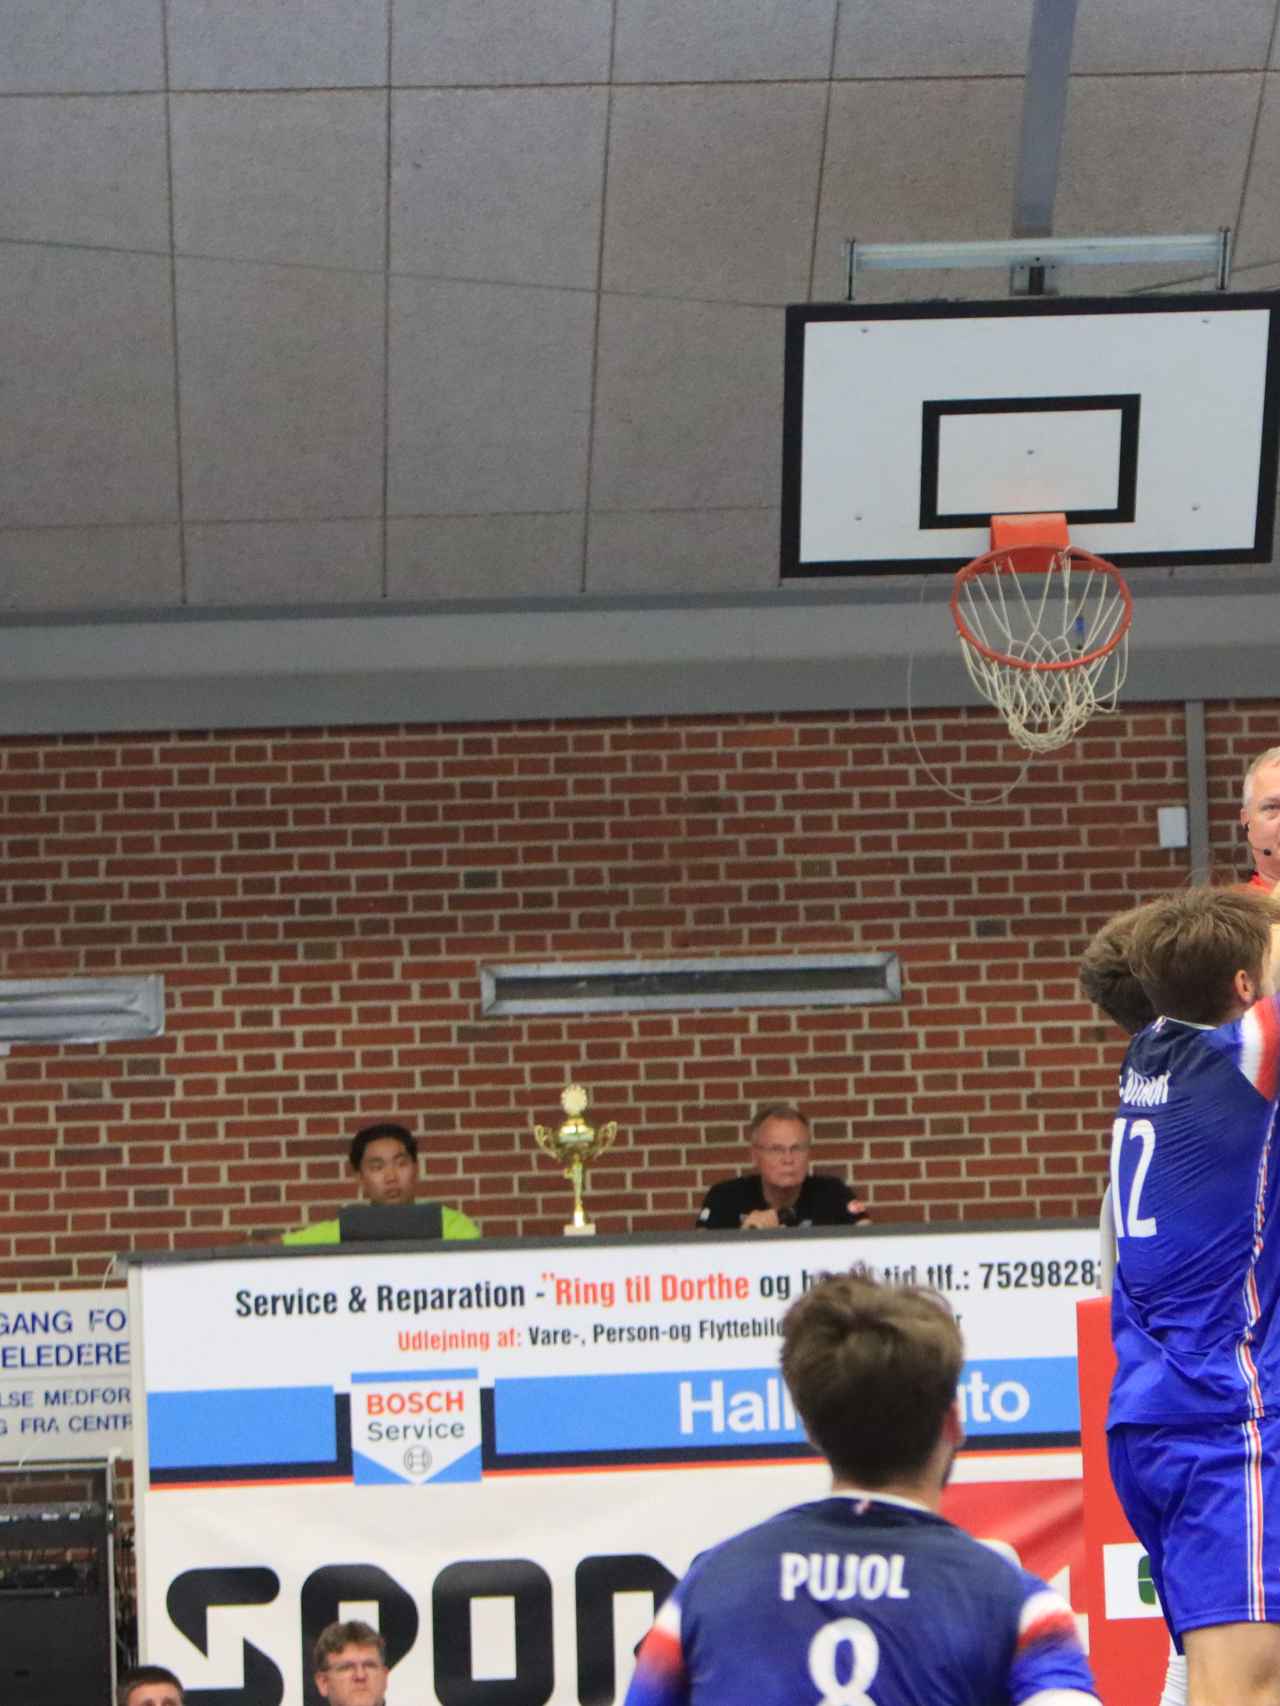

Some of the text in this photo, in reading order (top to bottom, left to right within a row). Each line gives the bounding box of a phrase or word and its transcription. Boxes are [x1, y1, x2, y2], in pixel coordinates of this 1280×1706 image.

[1110, 1117, 1157, 1238] 12
[235, 1287, 338, 1317] Service
[348, 1285, 367, 1313] &
[377, 1281, 525, 1314] Reparation
[625, 1274, 651, 1304] til
[661, 1272, 749, 1302] Dorthe
[760, 1275, 790, 1299] og
[397, 1329, 491, 1352] Udlejning
[497, 1328, 523, 1348] af:
[593, 1322, 692, 1344] Person-og
[366, 1390, 464, 1416] BOSCH
[20, 1416, 60, 1433] FRA
[367, 1418, 465, 1443] Service
[780, 1552, 911, 1601] PUJOL
[808, 1616, 880, 1706] 8
